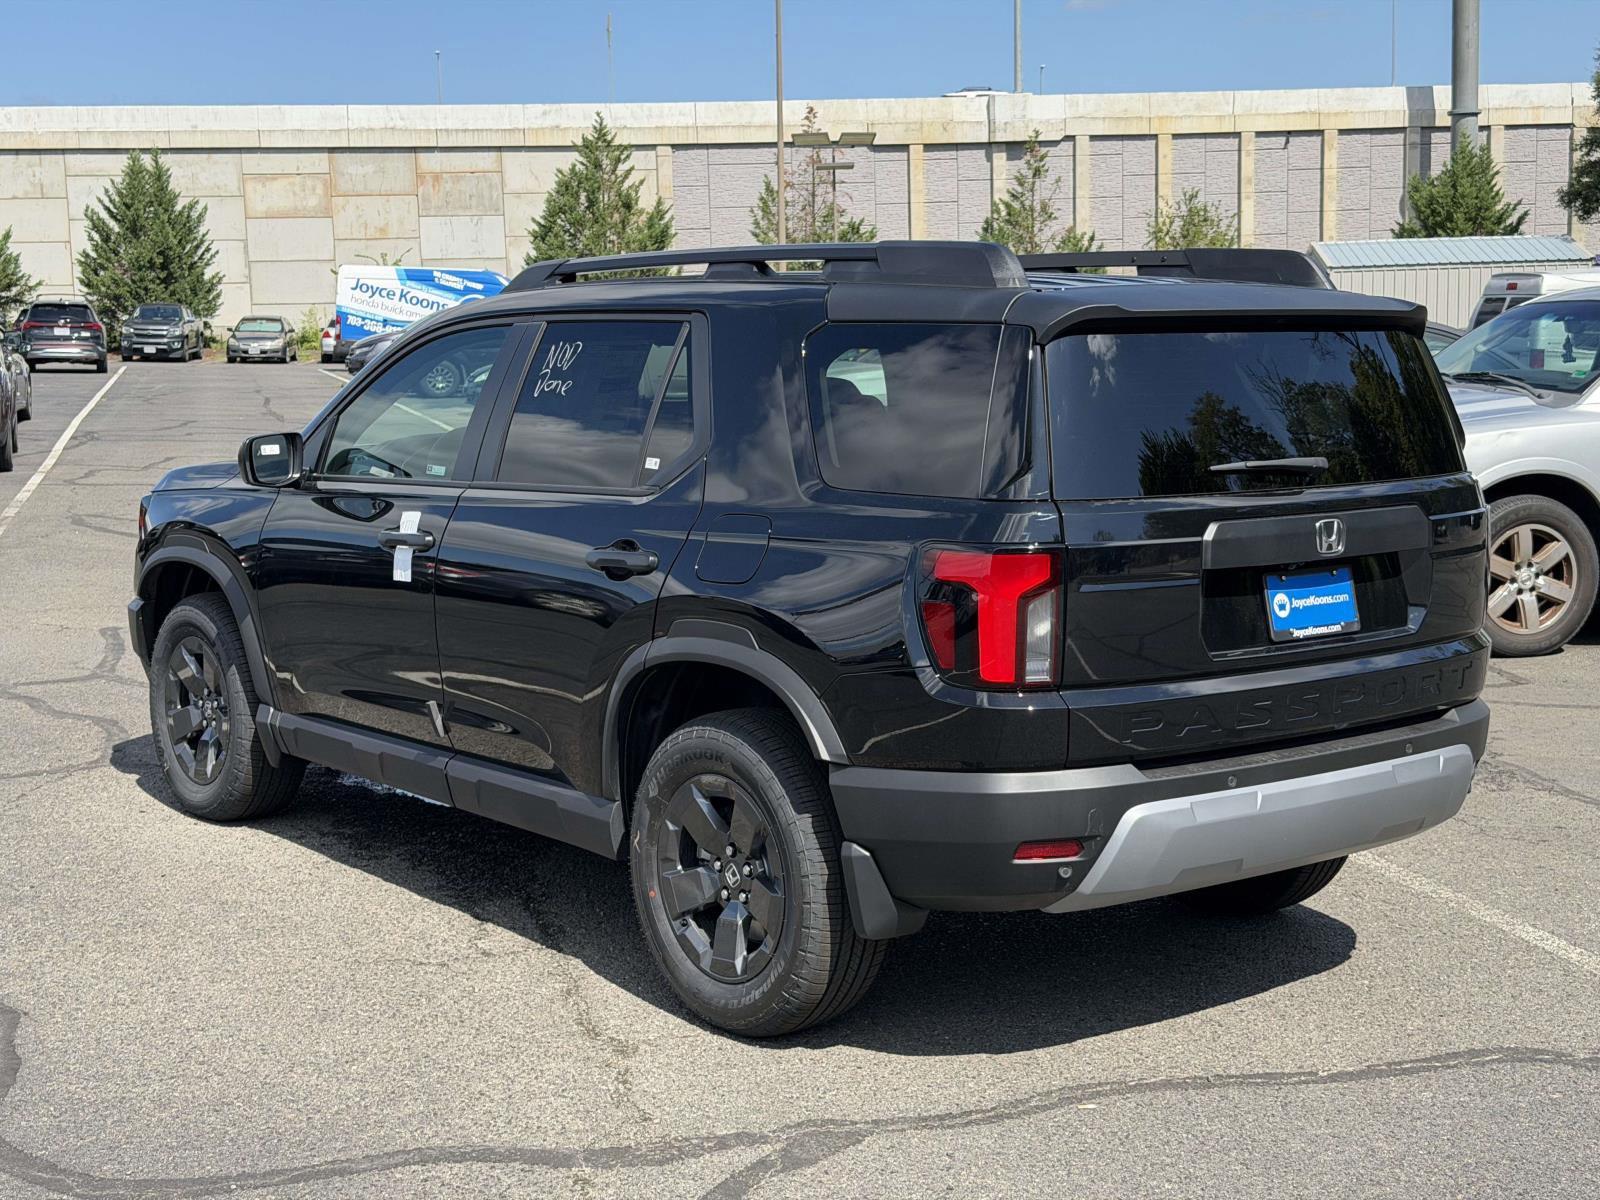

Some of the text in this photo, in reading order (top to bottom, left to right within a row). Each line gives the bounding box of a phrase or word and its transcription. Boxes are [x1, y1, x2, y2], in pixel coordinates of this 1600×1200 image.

[350, 278, 396, 300] Joyce
[398, 288, 449, 311] Koons
[350, 294, 380, 309] honda
[380, 303, 404, 316] buick
[534, 369, 573, 398] Done
[1291, 593, 1349, 609] JoyceKoons.com
[1119, 660, 1473, 744] PASSPORT
